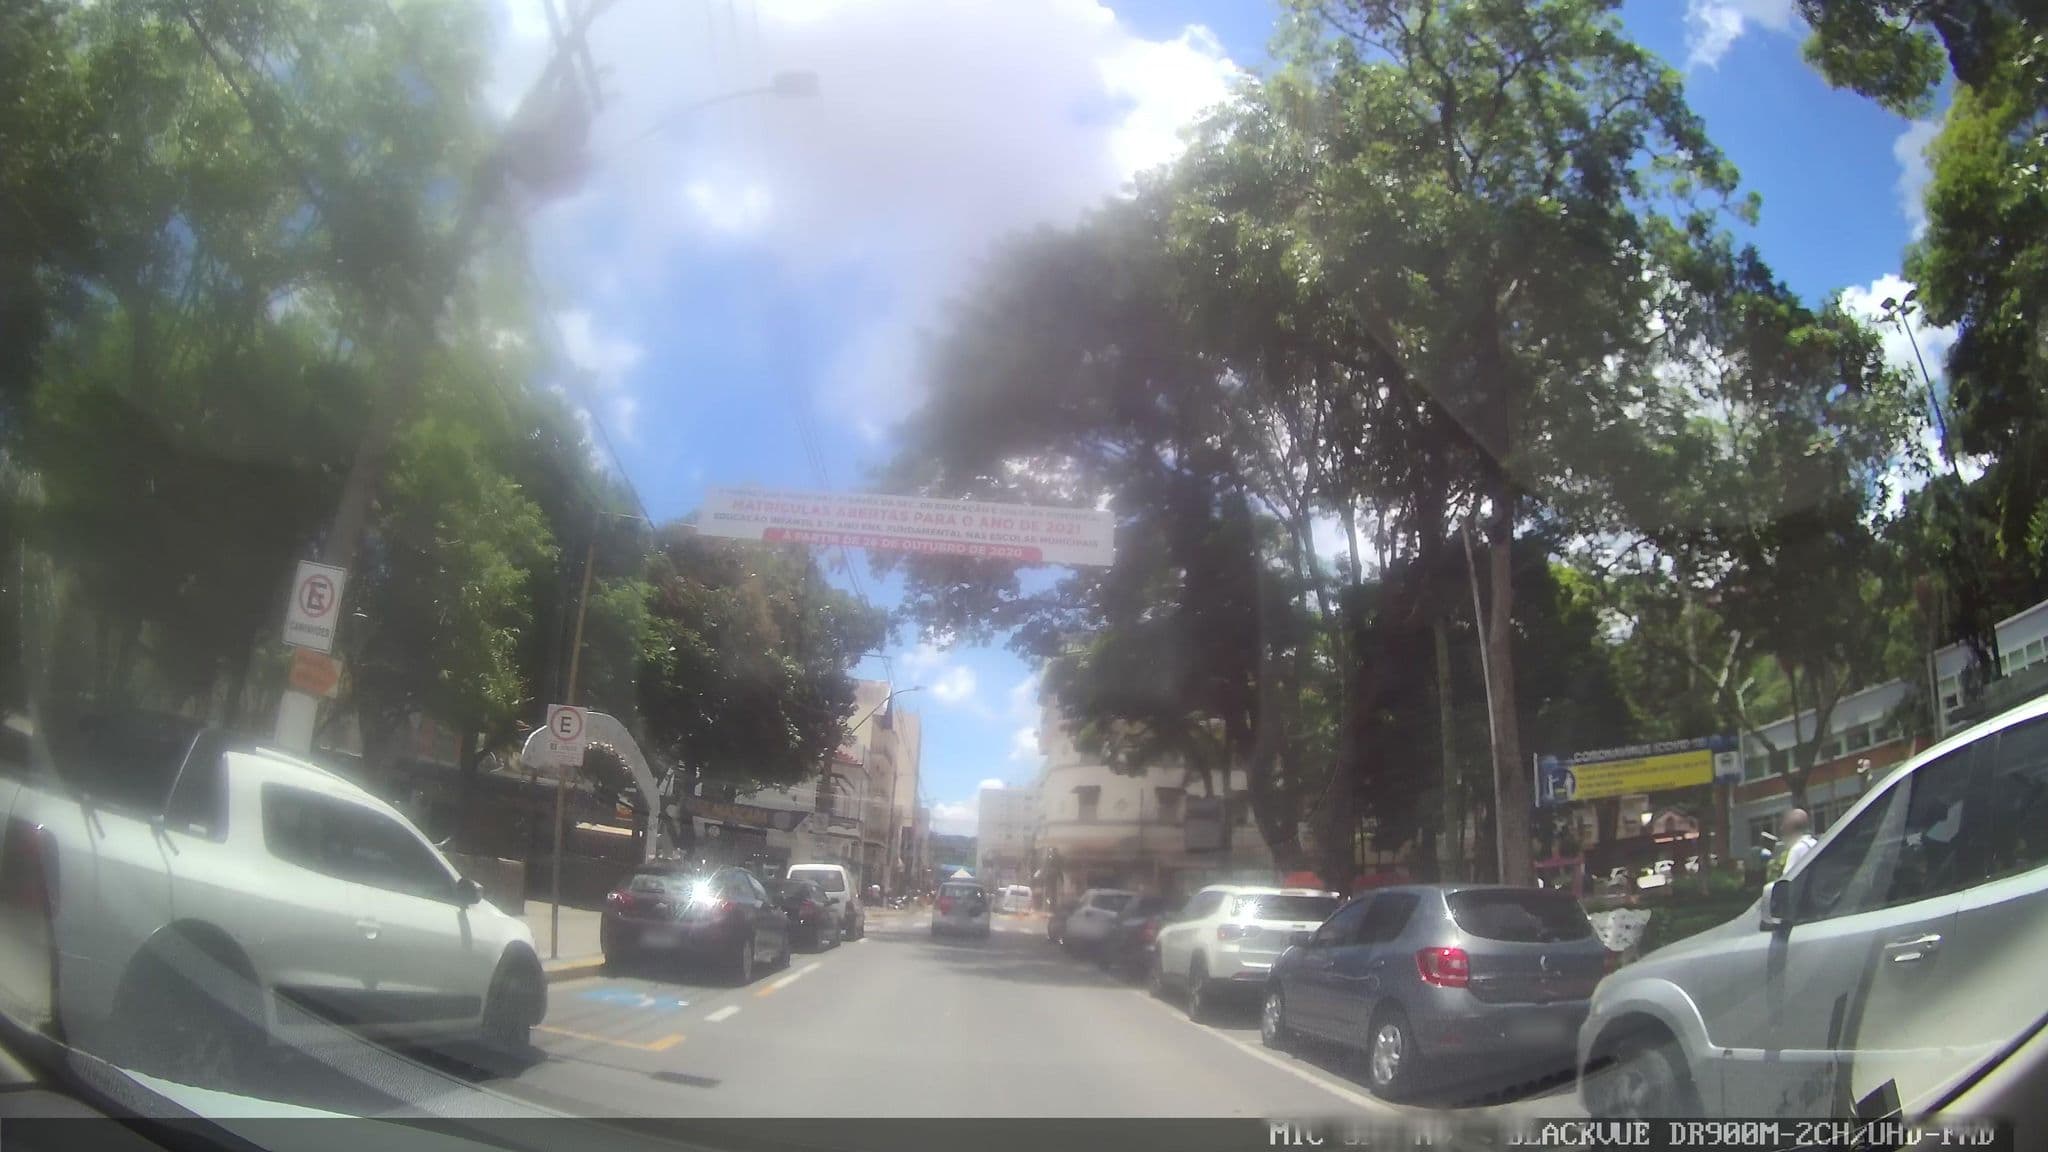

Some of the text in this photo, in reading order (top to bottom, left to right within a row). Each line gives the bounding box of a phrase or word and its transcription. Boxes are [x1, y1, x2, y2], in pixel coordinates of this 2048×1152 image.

[713, 511, 768, 521] EDUCAÇÃO
[887, 524, 961, 538] FUNDAMENTAL
[836, 505, 909, 523] ABERTAS
[914, 511, 956, 526] PARA
[962, 515, 973, 527] O
[980, 516, 1014, 529] ANO
[1020, 520, 1041, 531] DE
[1045, 521, 1081, 535] 2021
[794, 530, 839, 544] PARTIR
[846, 536, 858, 545] DE
[882, 539, 898, 548] DE
[902, 540, 965, 554] OUTUBRO
[969, 546, 986, 555] DE
[990, 546, 1023, 557] 2020
[560, 716, 571, 733] E
